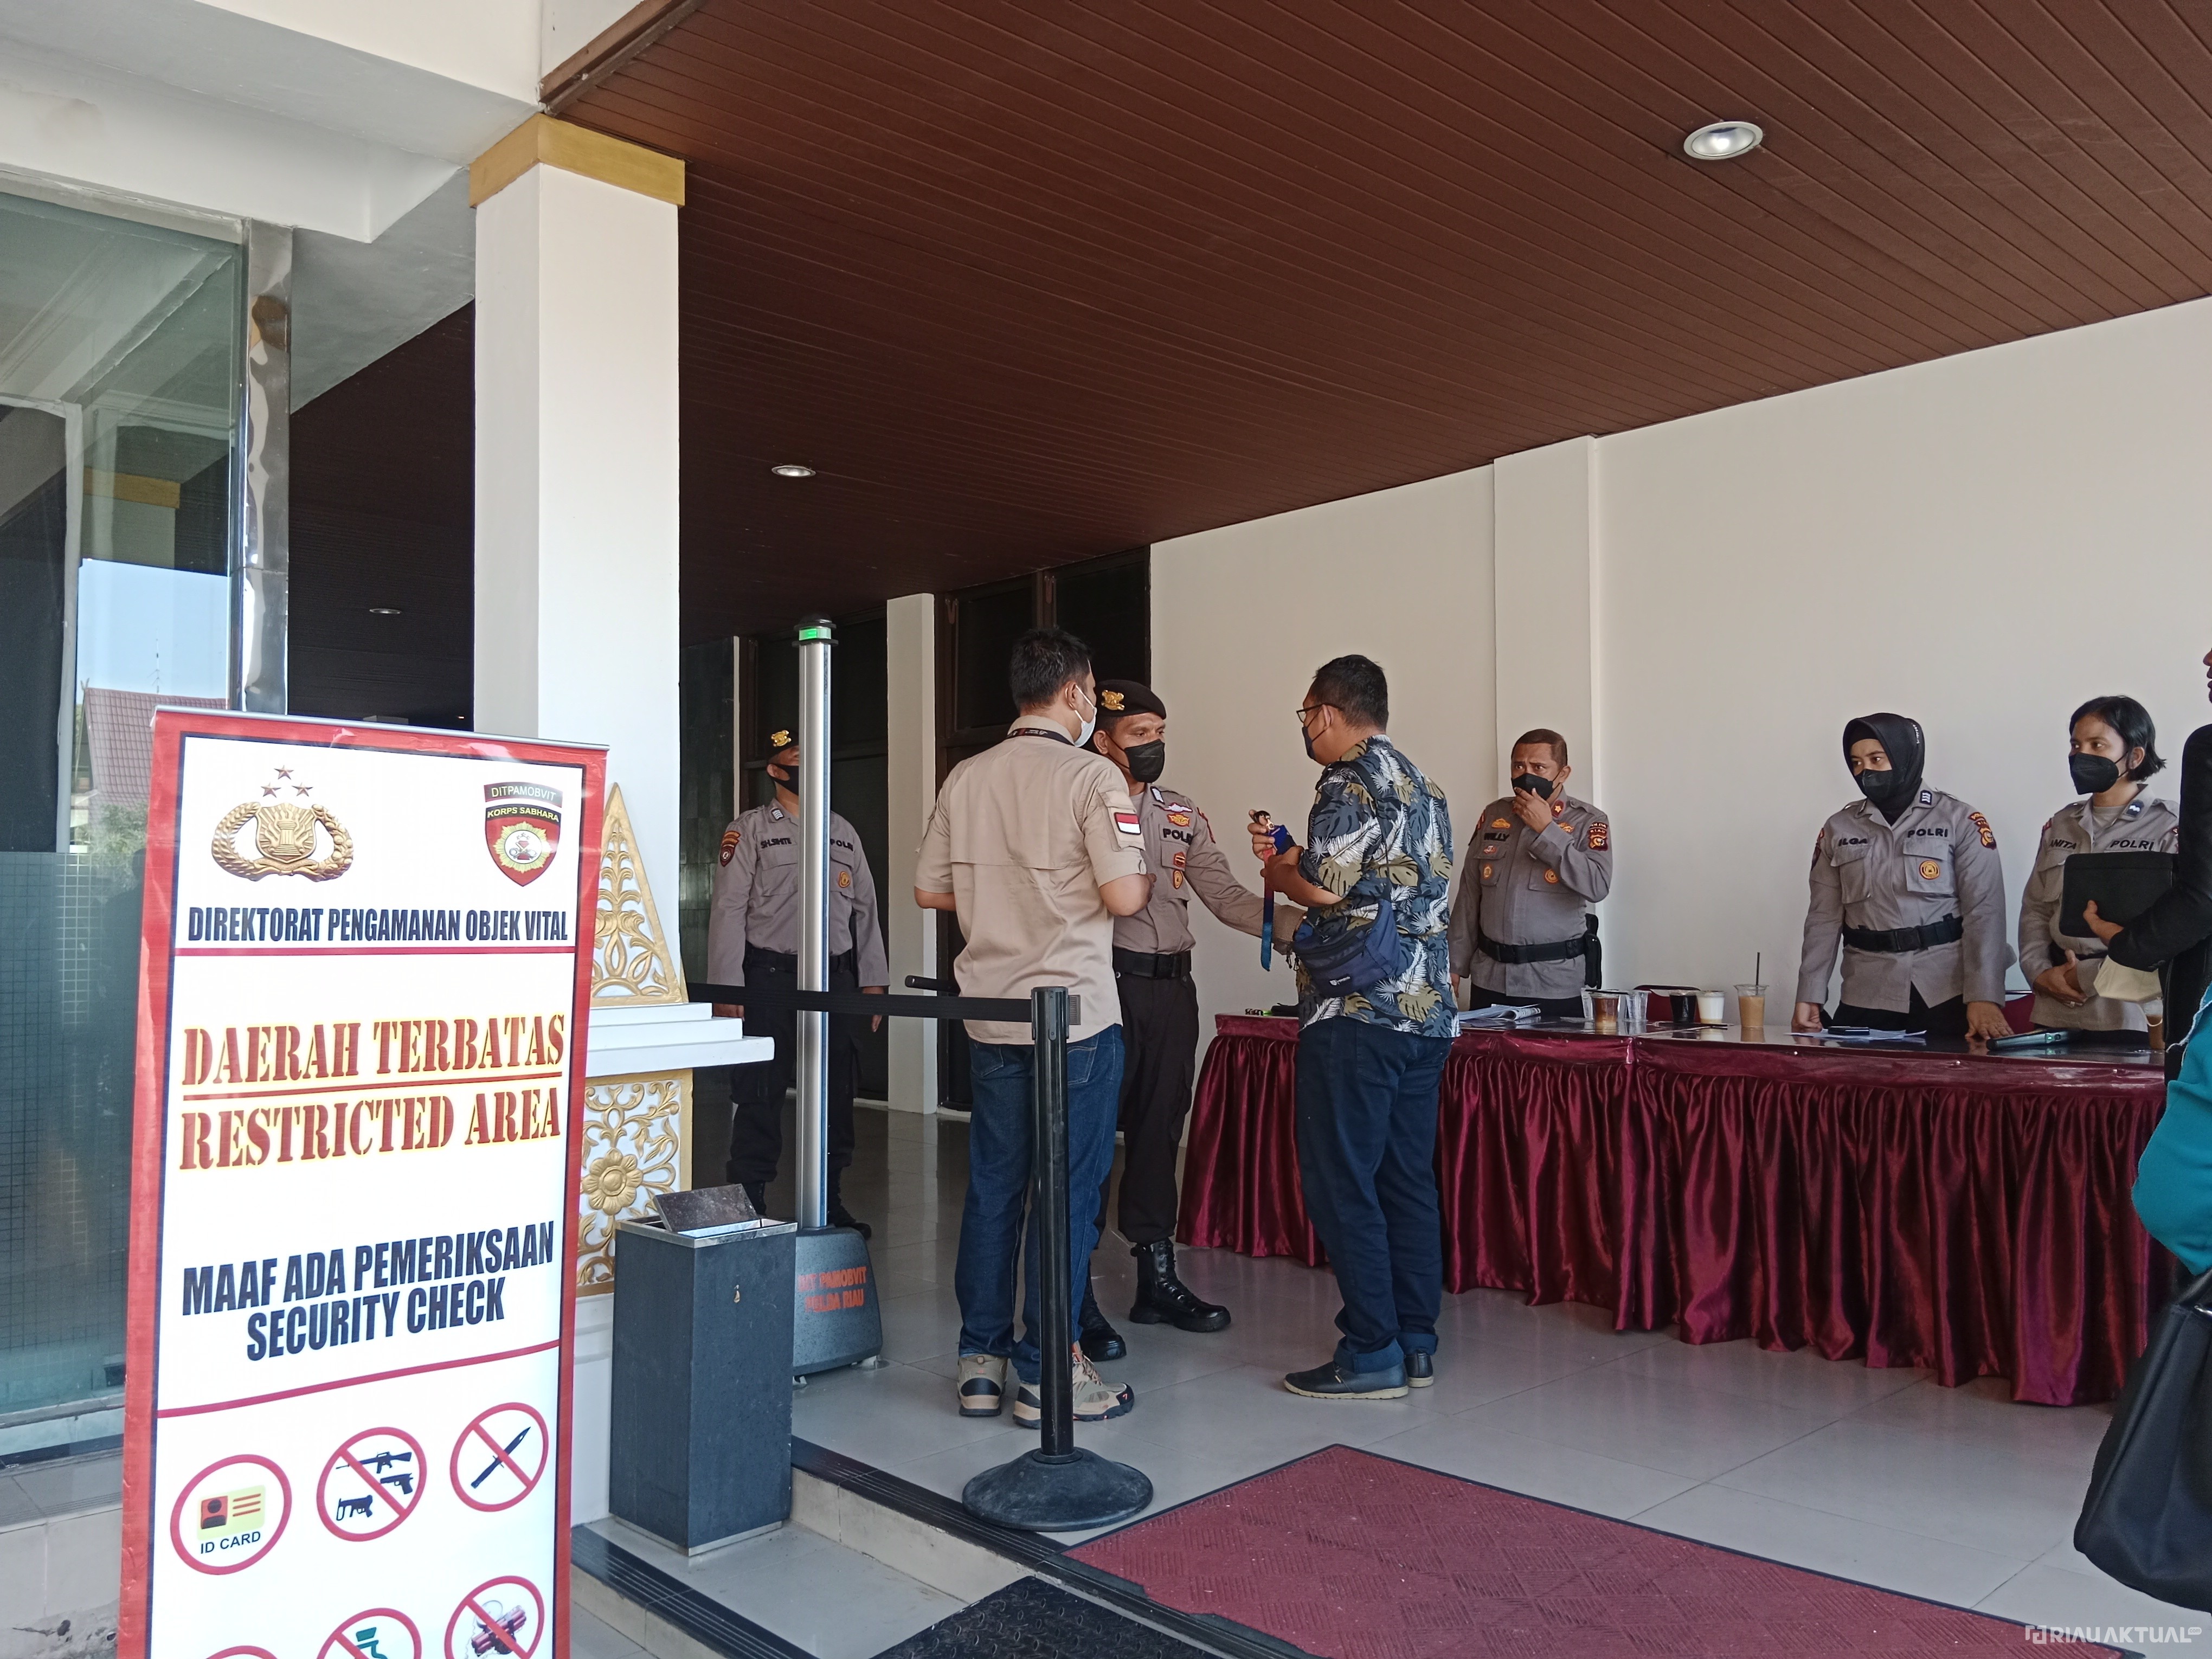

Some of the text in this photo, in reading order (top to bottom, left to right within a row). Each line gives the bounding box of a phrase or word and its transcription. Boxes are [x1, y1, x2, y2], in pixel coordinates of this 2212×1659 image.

[491, 786, 557, 801] DITPAMOBVIT
[487, 807, 560, 822] KORPS SABHARA
[1908, 827, 1949, 838] POLRI
[2110, 840, 2155, 851] POLRI
[188, 906, 568, 942] DIREKTORAT PENGAMANAN OBJEK VITAL
[182, 1014, 565, 1086] DAERAH TERBATAS
[179, 1087, 561, 1171] RESTRICTED AREA
[182, 1220, 555, 1316] MAAF ADA PEMERIKSAAN
[842, 1288, 864, 1309] RIAU
[247, 1277, 506, 1361] SECURITY CHECK
[200, 1531, 261, 1554] ID CARD
